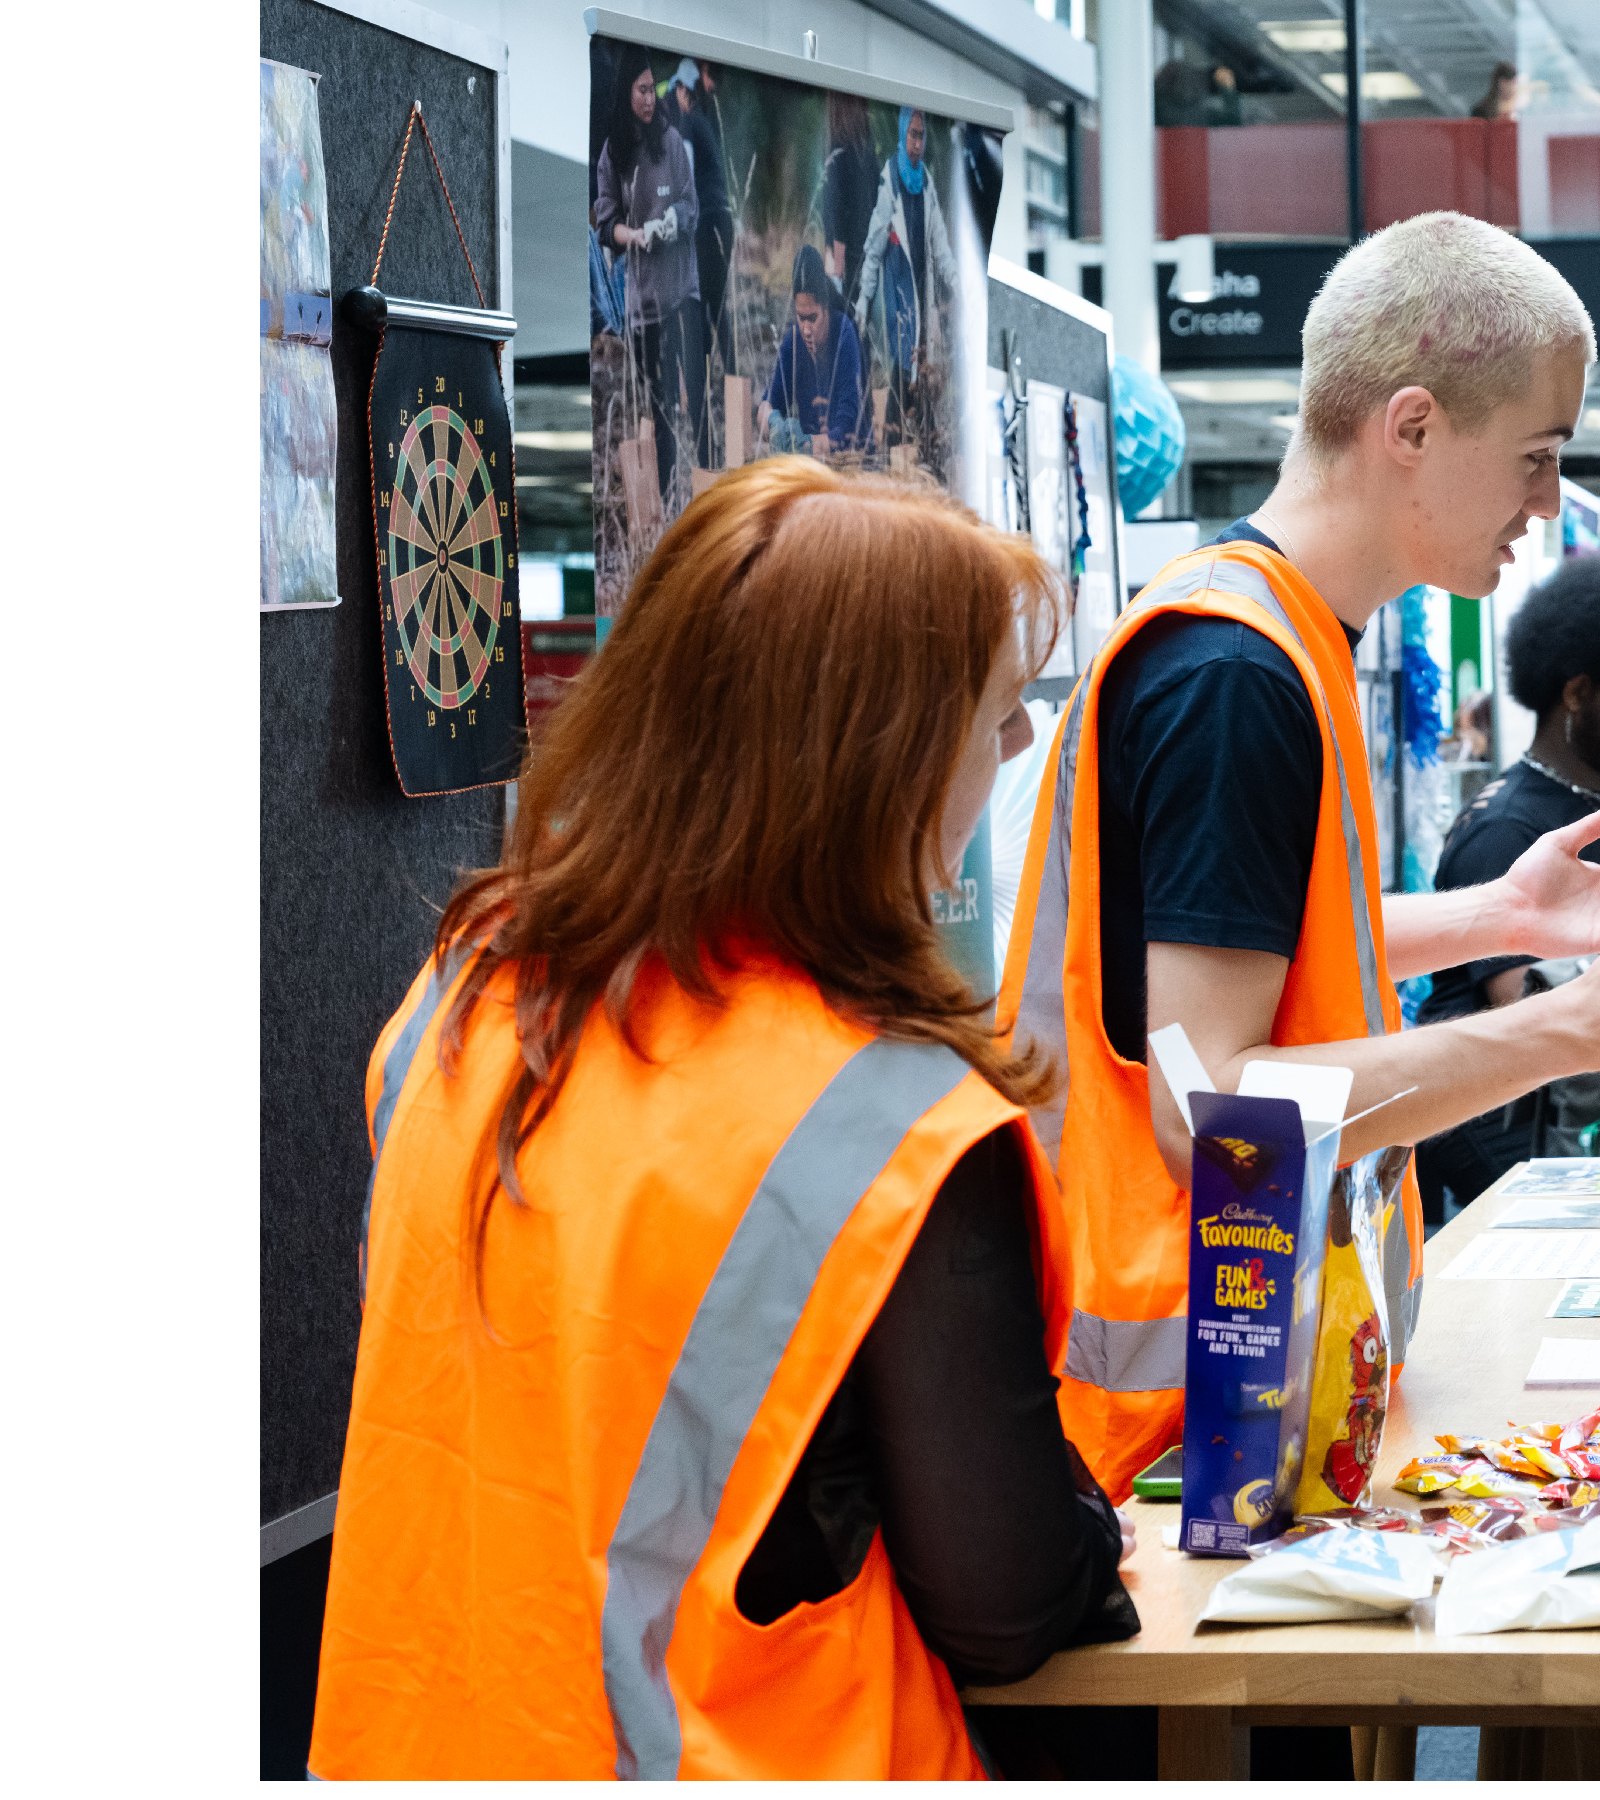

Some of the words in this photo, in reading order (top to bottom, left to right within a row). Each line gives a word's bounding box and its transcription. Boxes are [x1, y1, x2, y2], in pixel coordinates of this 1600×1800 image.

[1169, 307, 1263, 336] Create
[435, 376, 445, 392] 20
[418, 388, 423, 404] 5
[458, 392, 463, 407] 1
[400, 409, 408, 426] 12
[474, 419, 484, 435] 18
[389, 442, 394, 458] 9
[490, 452, 496, 467] 4
[380, 491, 390, 507] 14
[499, 502, 508, 517] 13
[380, 549, 387, 566] 11
[508, 553, 514, 568] 6
[386, 604, 392, 621] 8
[503, 602, 512, 617] 10
[395, 650, 404, 665] 16
[495, 647, 504, 662] 15
[411, 686, 415, 701] 7
[485, 683, 490, 698] 2
[427, 710, 436, 727] 19
[468, 710, 477, 725] 17
[450, 723, 456, 738] 3
[1222, 1202, 1274, 1225] Cadbury
[1197, 1215, 1294, 1255] Favourites
[1216, 1264, 1251, 1288] FUN
[1215, 1287, 1267, 1310] GAMES
[1232, 1313, 1250, 1323] VISIT
[1198, 1328, 1217, 1341] FOR
[1246, 1333, 1280, 1347] GAMES
[1209, 1342, 1229, 1354] AND
[1232, 1344, 1265, 1357] TRIVIA
